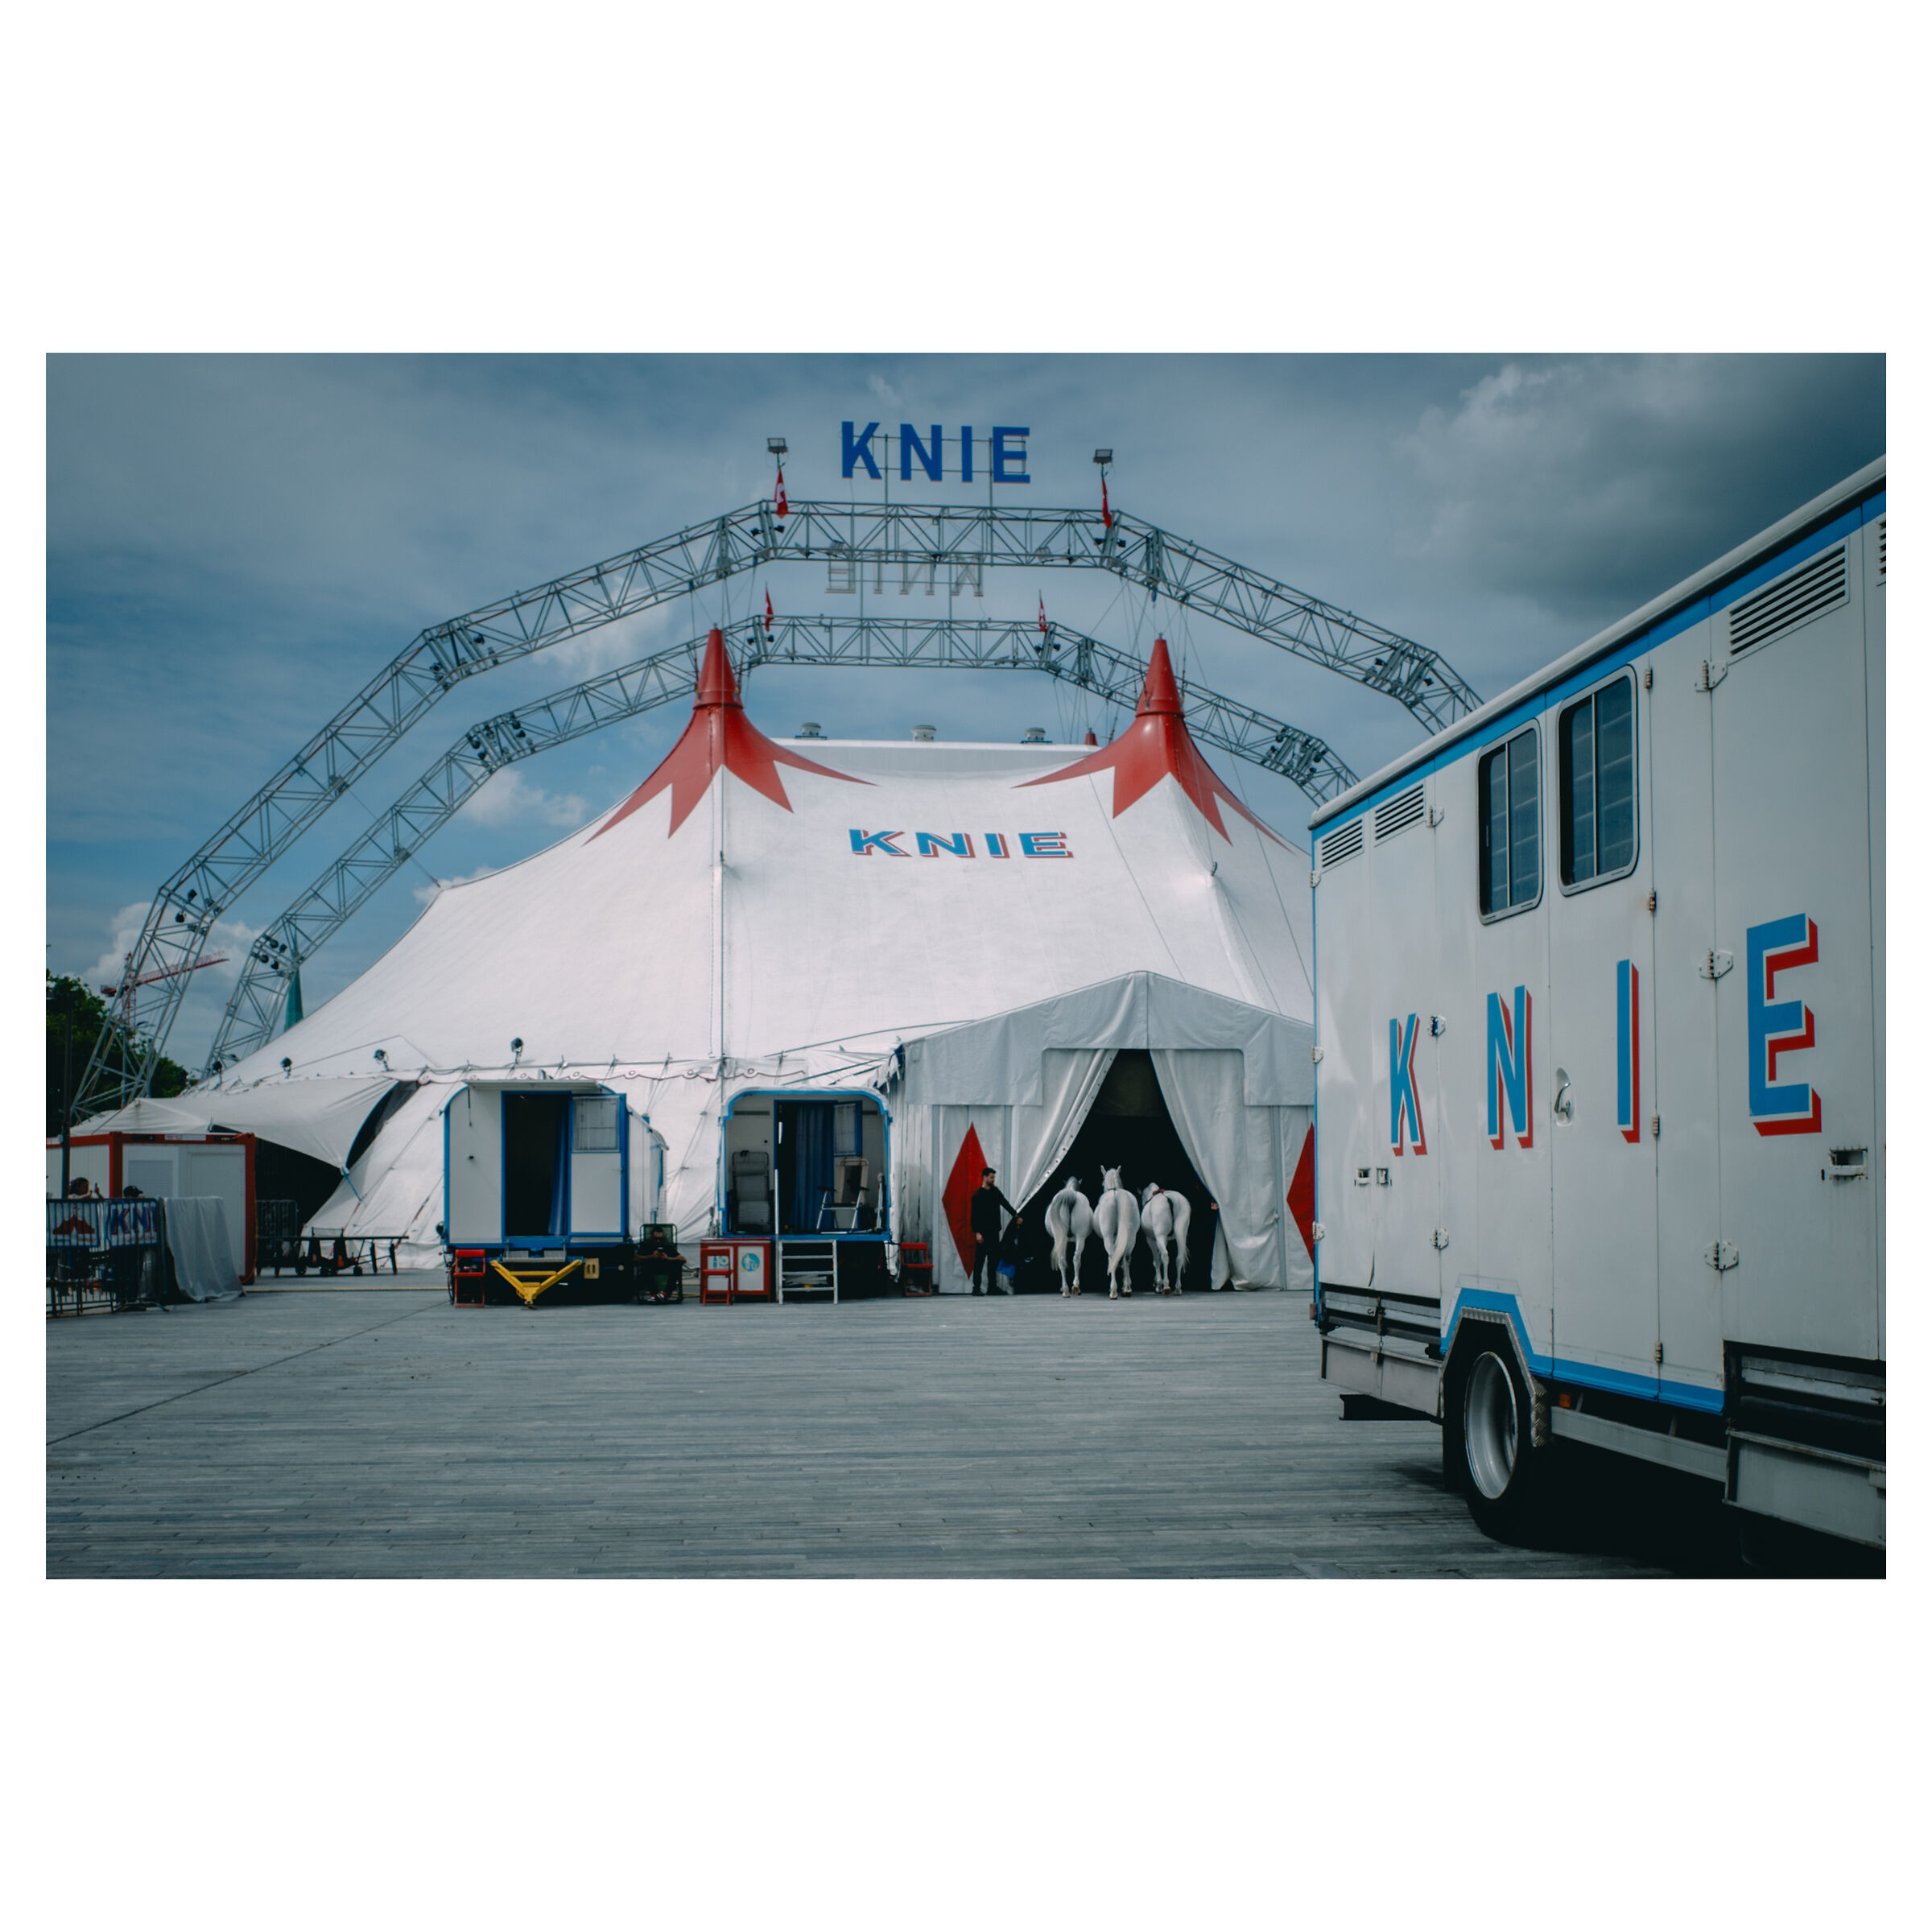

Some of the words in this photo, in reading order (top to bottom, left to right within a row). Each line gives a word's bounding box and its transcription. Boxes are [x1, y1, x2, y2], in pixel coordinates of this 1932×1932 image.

[841, 421, 1030, 483] KNIE
[848, 828, 1074, 858] KNIE
[1389, 913, 1822, 1157] KNIE
